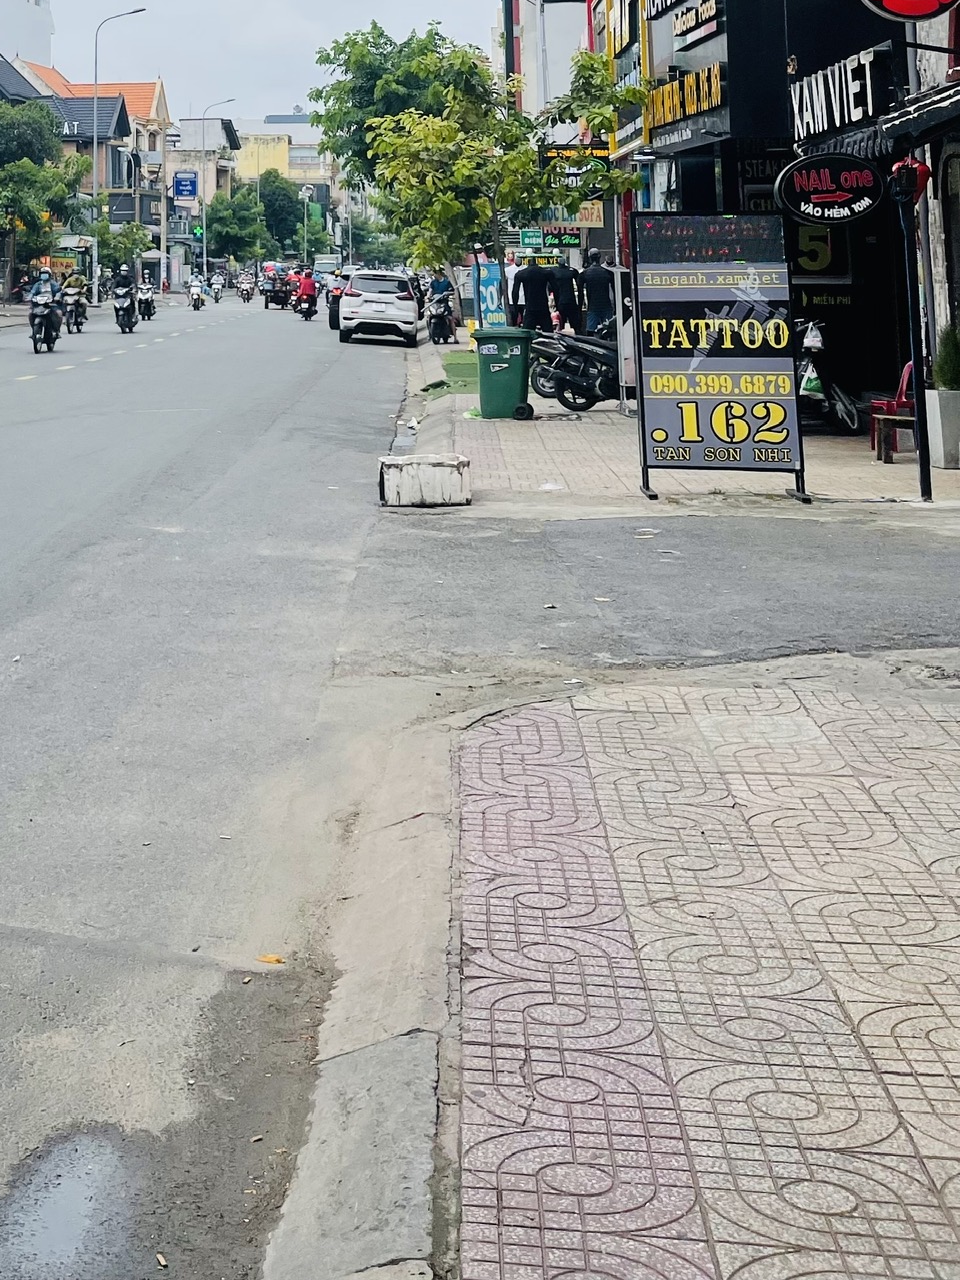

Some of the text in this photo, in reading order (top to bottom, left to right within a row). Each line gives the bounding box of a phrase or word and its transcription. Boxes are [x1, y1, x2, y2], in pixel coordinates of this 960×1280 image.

[794, 168, 874, 193] NAIL one
[800, 202, 822, 216] VÀO
[851, 196, 873, 213] 10M
[642, 319, 789, 348] TATTOO
[649, 374, 790, 394] 090.399.6879
[653, 447, 791, 462] TAN SON NHI
